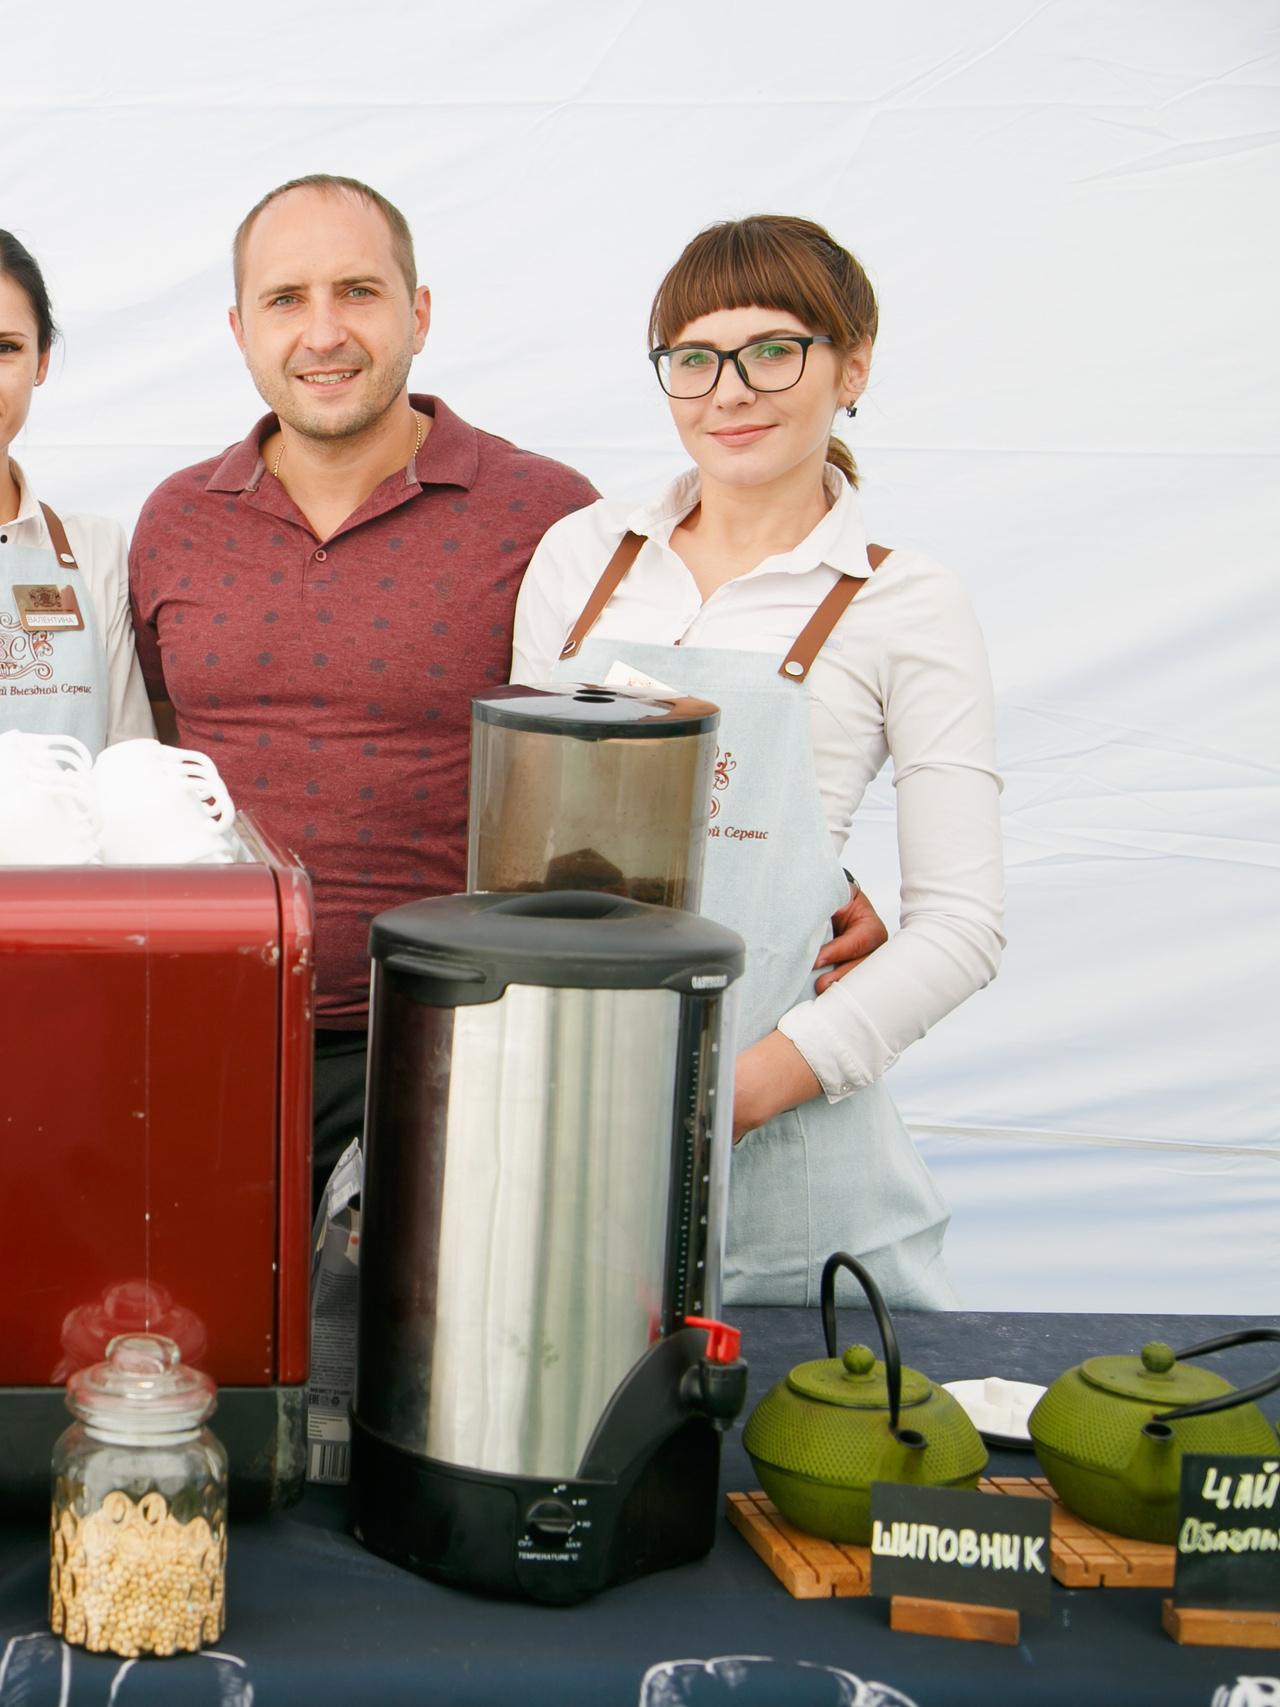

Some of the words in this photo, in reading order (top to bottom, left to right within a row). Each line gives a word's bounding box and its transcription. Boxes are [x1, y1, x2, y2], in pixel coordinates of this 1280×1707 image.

[27, 615, 74, 624] ВАЛЕНТИНА
[10, 683, 58, 696] Выездной
[61, 682, 92, 695] Сервис
[724, 826, 769, 841] Сервис
[1201, 1461, 1280, 1510] ЧАЙ
[871, 1519, 1046, 1575] ШИПОВНИК
[518, 1551, 570, 1561] TEMPERATURE
